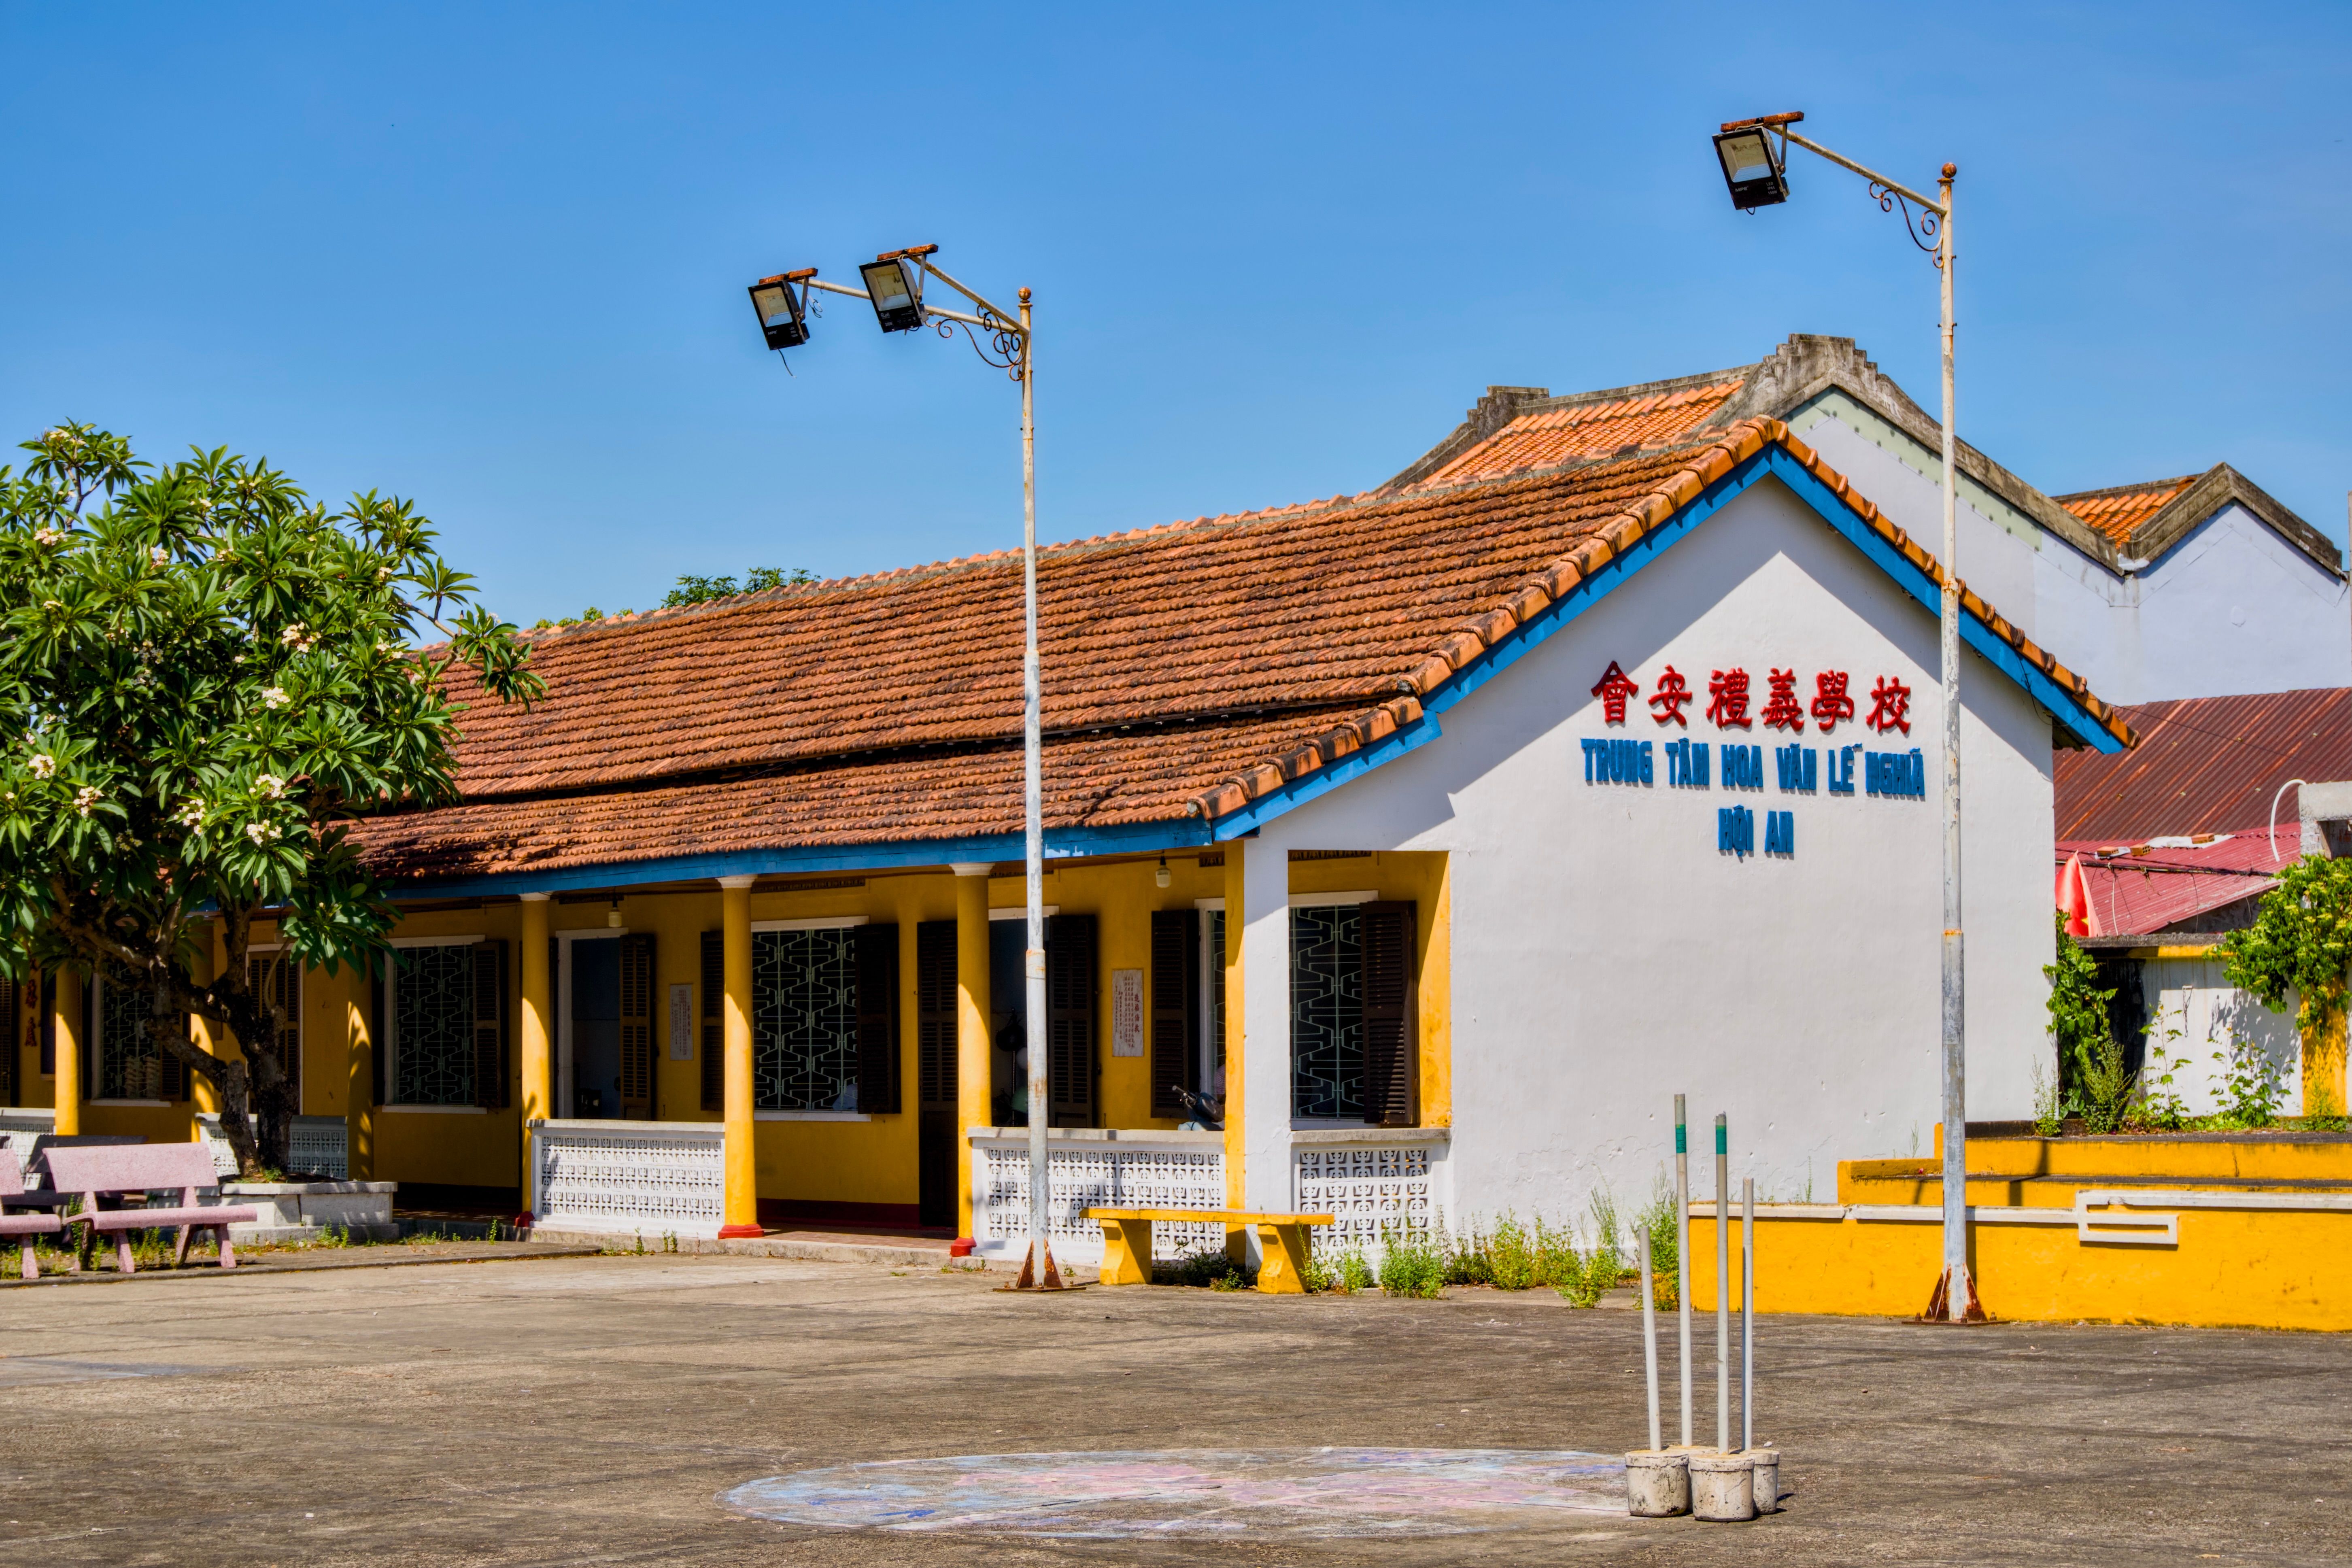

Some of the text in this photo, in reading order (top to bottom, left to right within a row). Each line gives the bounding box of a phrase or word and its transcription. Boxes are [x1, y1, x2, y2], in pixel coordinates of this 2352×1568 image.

[1591, 661, 1911, 734] 會安禮義學校
[1581, 738, 1653, 783] TRUNG
[1665, 737, 1710, 786] TÂM
[1721, 744, 1763, 788] HOA
[1776, 743, 1817, 790] VĂN
[1718, 805, 1794, 857] HỘI AN
